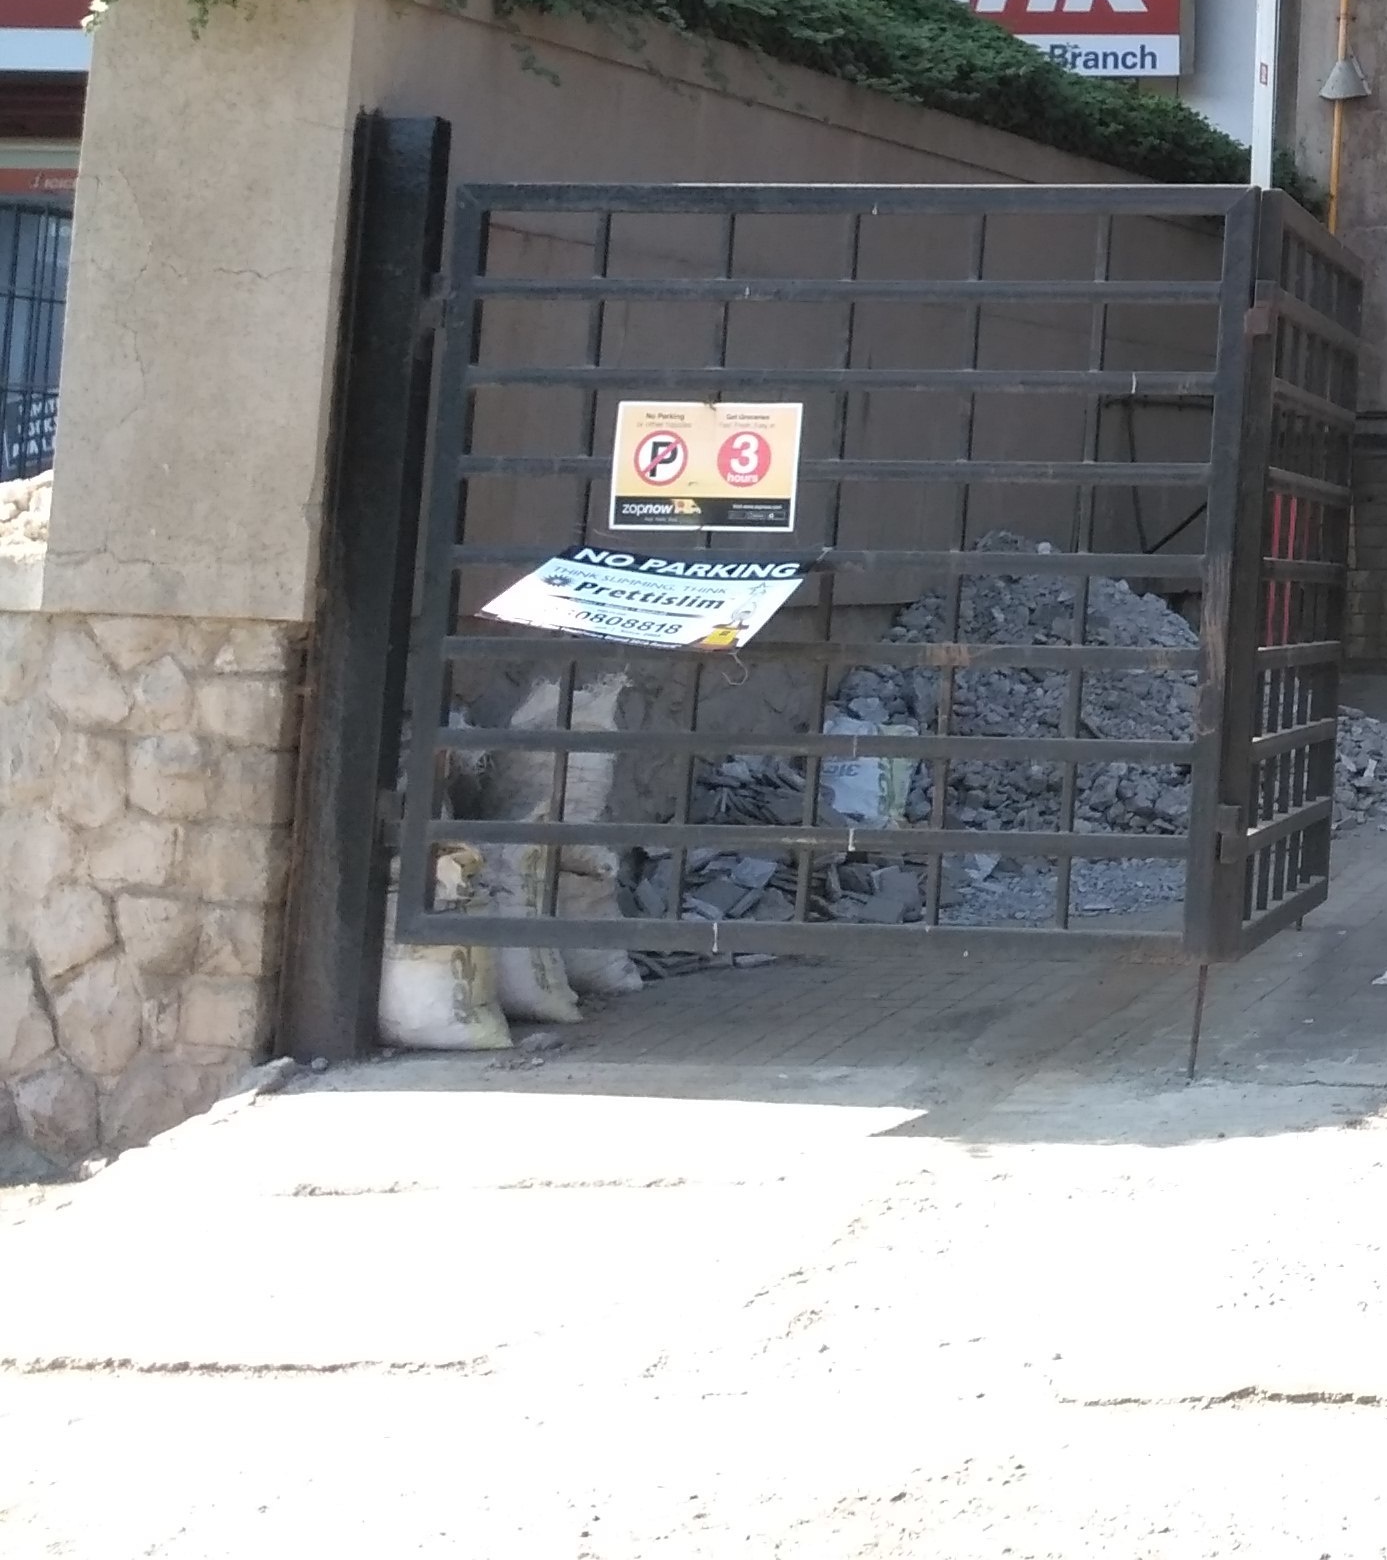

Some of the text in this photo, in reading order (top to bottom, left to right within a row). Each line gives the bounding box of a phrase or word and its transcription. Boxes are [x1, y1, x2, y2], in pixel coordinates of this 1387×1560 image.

[1048, 44, 1158, 70] Branch
[658, 413, 685, 421] Parking
[649, 441, 679, 477] P
[730, 433, 759, 474] 3
[727, 472, 759, 483] hours
[621, 503, 674, 517] zopnow
[573, 548, 800, 579] NO PARKING
[553, 566, 598, 580] THINK
[683, 585, 728, 595] THINK
[573, 581, 726, 610] Prettislim
